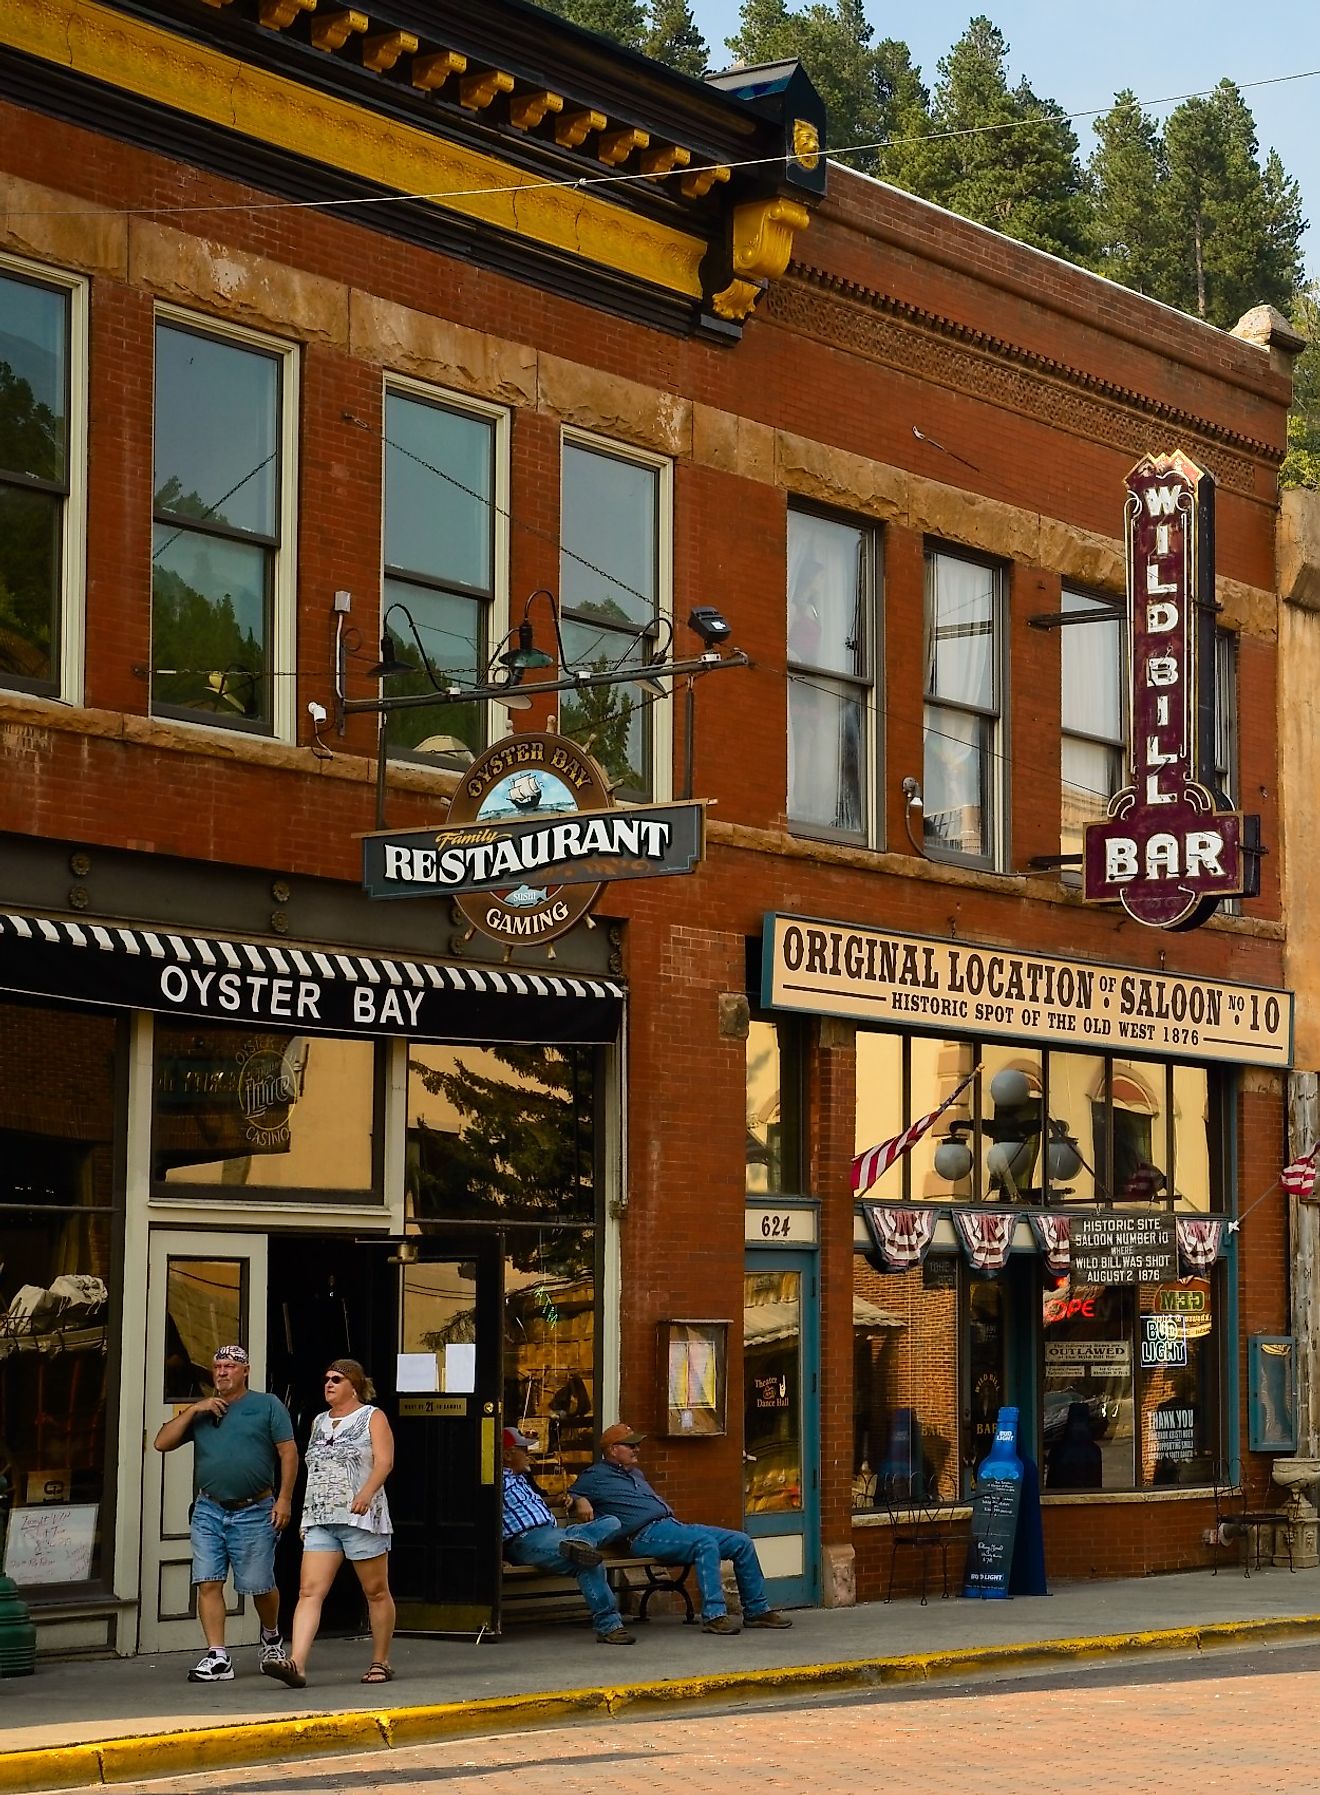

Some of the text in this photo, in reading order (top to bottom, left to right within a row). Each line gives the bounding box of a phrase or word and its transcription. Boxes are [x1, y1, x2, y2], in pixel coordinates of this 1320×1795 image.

[1144, 484, 1181, 634] WILD
[1145, 657, 1179, 805] BILL
[467, 741, 593, 799] OYSTER BAY
[435, 827, 511, 851] Family
[384, 819, 670, 884] RESTAURANT
[1105, 832, 1225, 884] BAR
[486, 901, 569, 936] GAMING
[783, 925, 939, 989] ORIGINAL
[947, 950, 1094, 1009] LOCATION
[1099, 975, 1117, 993] OF
[1120, 975, 1223, 1026] SALOON
[1250, 995, 1280, 1034] 10
[160, 965, 425, 1026] OYSTER BAY
[891, 992, 1199, 1046] HISTORIC SPOT OF THE OLD WEST 1876
[246, 1127, 290, 1146] CASINO
[761, 1215, 791, 1237] 624
[1083, 1218, 1162, 1233] HISTORIC SITE
[1075, 1233, 1113, 1247] SALOON
[1115, 1232, 1156, 1245] NUMBER
[1075, 1254, 1171, 1269] WILD BILL WAS SHOT
[1110, 1246, 1134, 1256] WHERE
[1086, 1269, 1160, 1283] AUGUST 2 1876
[1146, 1320, 1178, 1340] BUD
[1049, 1347, 1125, 1356] OUTLAWED
[1141, 1341, 1185, 1362] LIGHT
[425, 1401, 433, 1411] 21
[1147, 1409, 1194, 1430] THANK YOU
